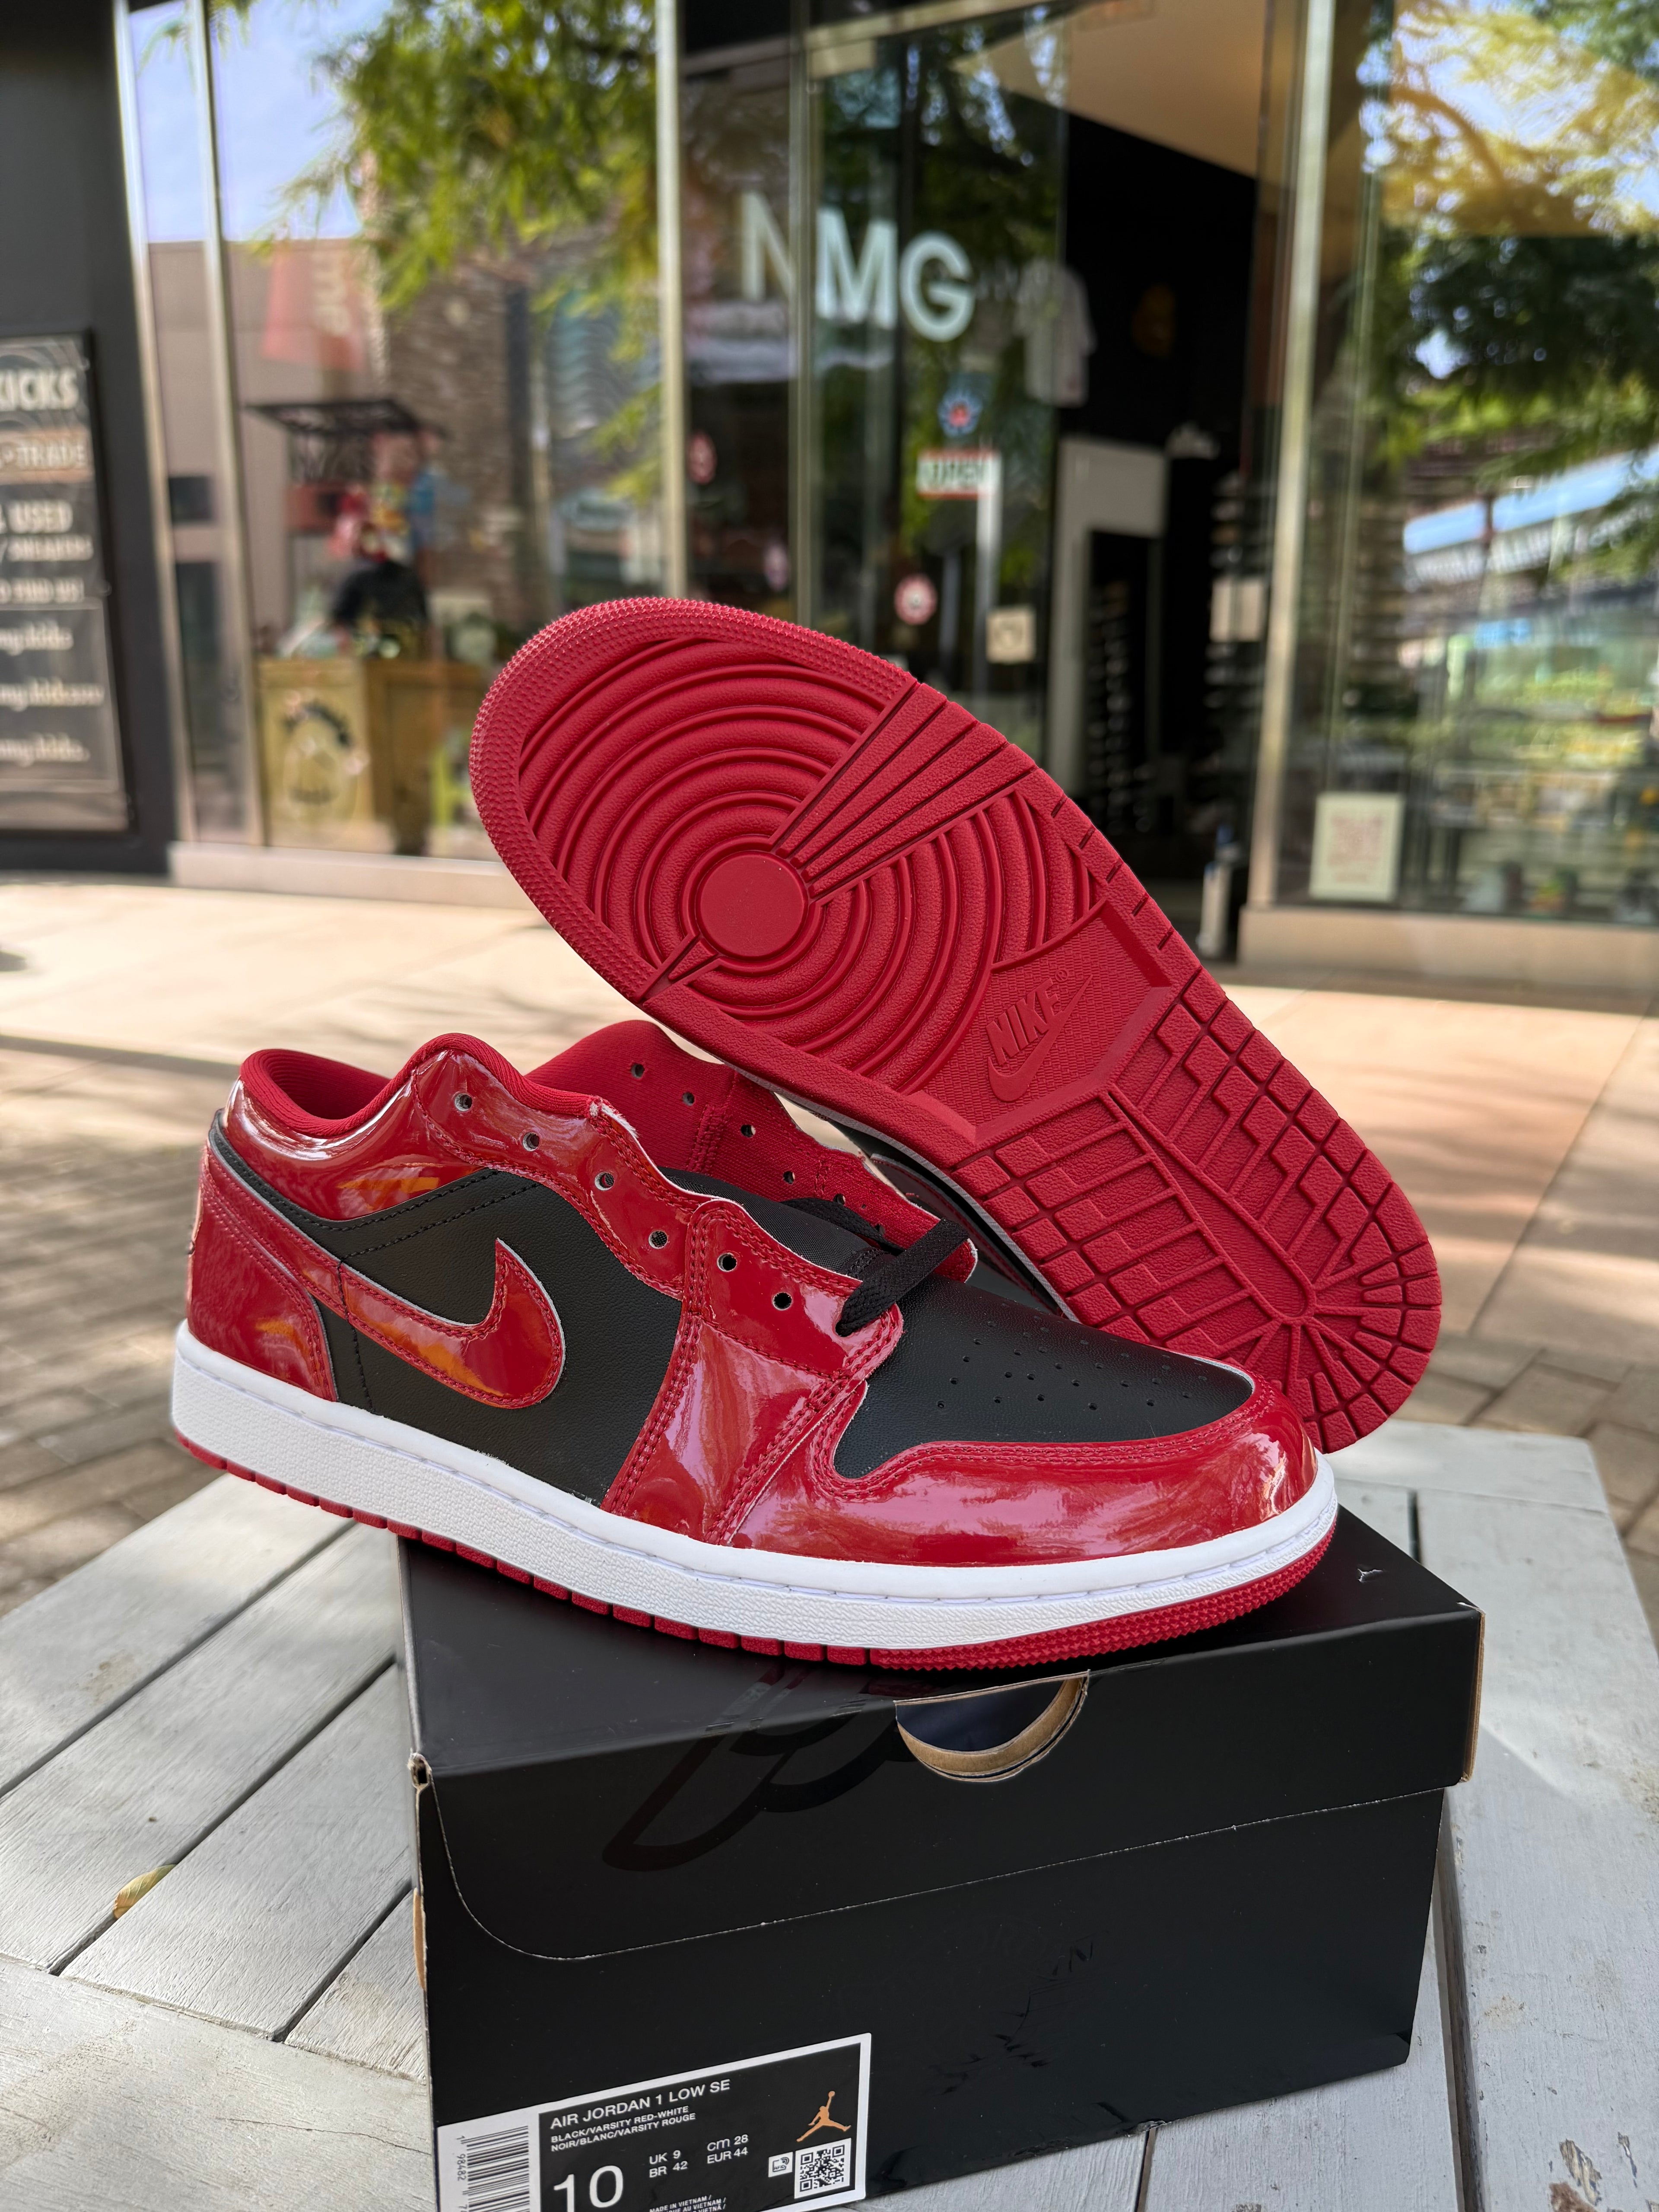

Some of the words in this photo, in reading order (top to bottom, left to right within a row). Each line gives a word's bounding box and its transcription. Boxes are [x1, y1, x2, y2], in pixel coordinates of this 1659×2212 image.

[741, 191, 976, 342] NMG
[985, 978, 1059, 1066] NIKE
[550, 2113, 578, 2129] AIR
[583, 2097, 650, 2122] JORDAN
[656, 2094, 663, 2105] 1
[670, 2085, 706, 2102] LOW
[710, 2079, 730, 2092] SE
[551, 2119, 631, 2143] BLACK/VARSITY
[634, 2106, 689, 2124] RED-WHITE
[551, 2122, 659, 2152] NOIR/BLANC/VARSITY
[662, 2113, 696, 2127] ROUGE
[707, 2139, 730, 2151] cm
[734, 2134, 748, 2145] 28
[707, 2151, 732, 2164] EUR
[734, 2147, 748, 2156] 44
[649, 2153, 667, 2164] UK
[673, 2150, 681, 2159] 9
[649, 2166, 667, 2177] BR
[673, 2161, 688, 2171] 42
[554, 2165, 623, 2212] 10
[678, 2196, 707, 2207] VIETNAM
[693, 2199, 721, 2210] VIETNAM
